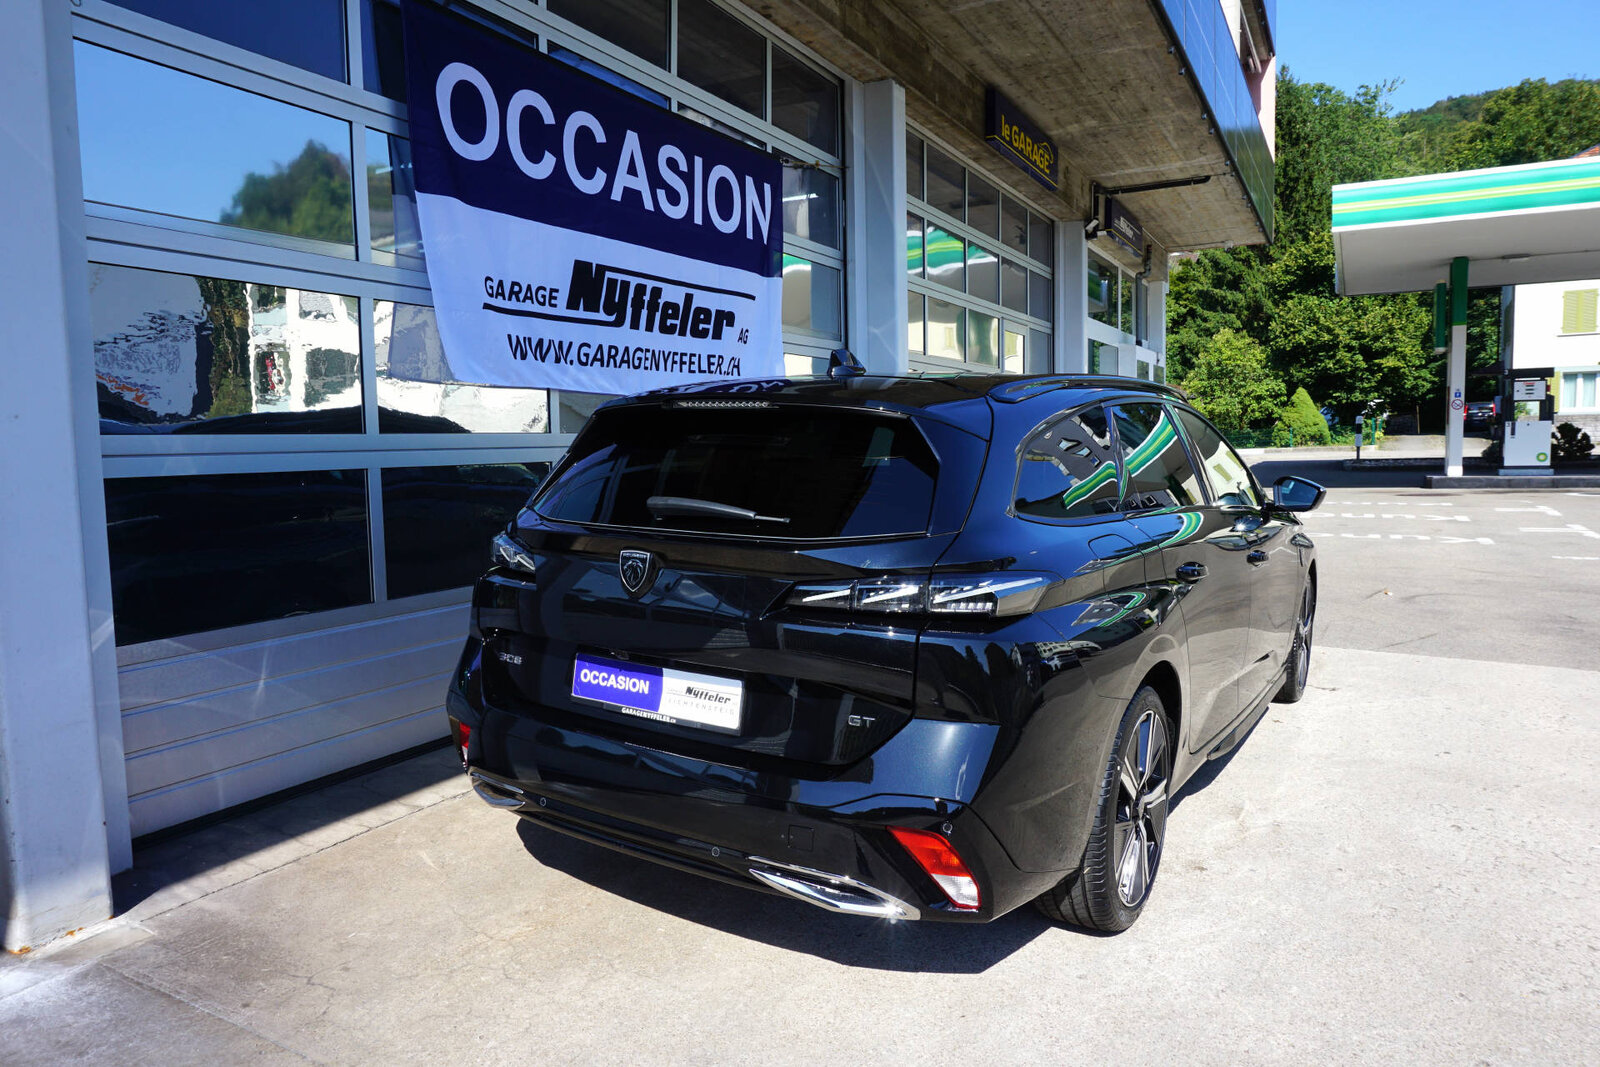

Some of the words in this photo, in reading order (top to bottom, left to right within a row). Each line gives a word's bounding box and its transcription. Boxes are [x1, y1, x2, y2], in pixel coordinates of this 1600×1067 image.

[435, 62, 772, 245] OCCASION
[1001, 114, 1010, 141] le
[1011, 125, 1050, 174] GARAGE
[484, 276, 559, 308] GARAGE
[566, 259, 736, 341] Nyffeler
[737, 327, 750, 345] AG
[507, 333, 742, 377] WWW.GARAGENYFFELER.CH
[580, 668, 650, 695] OCCASION
[684, 685, 732, 706] Nyffeler
[848, 714, 876, 728] GT
